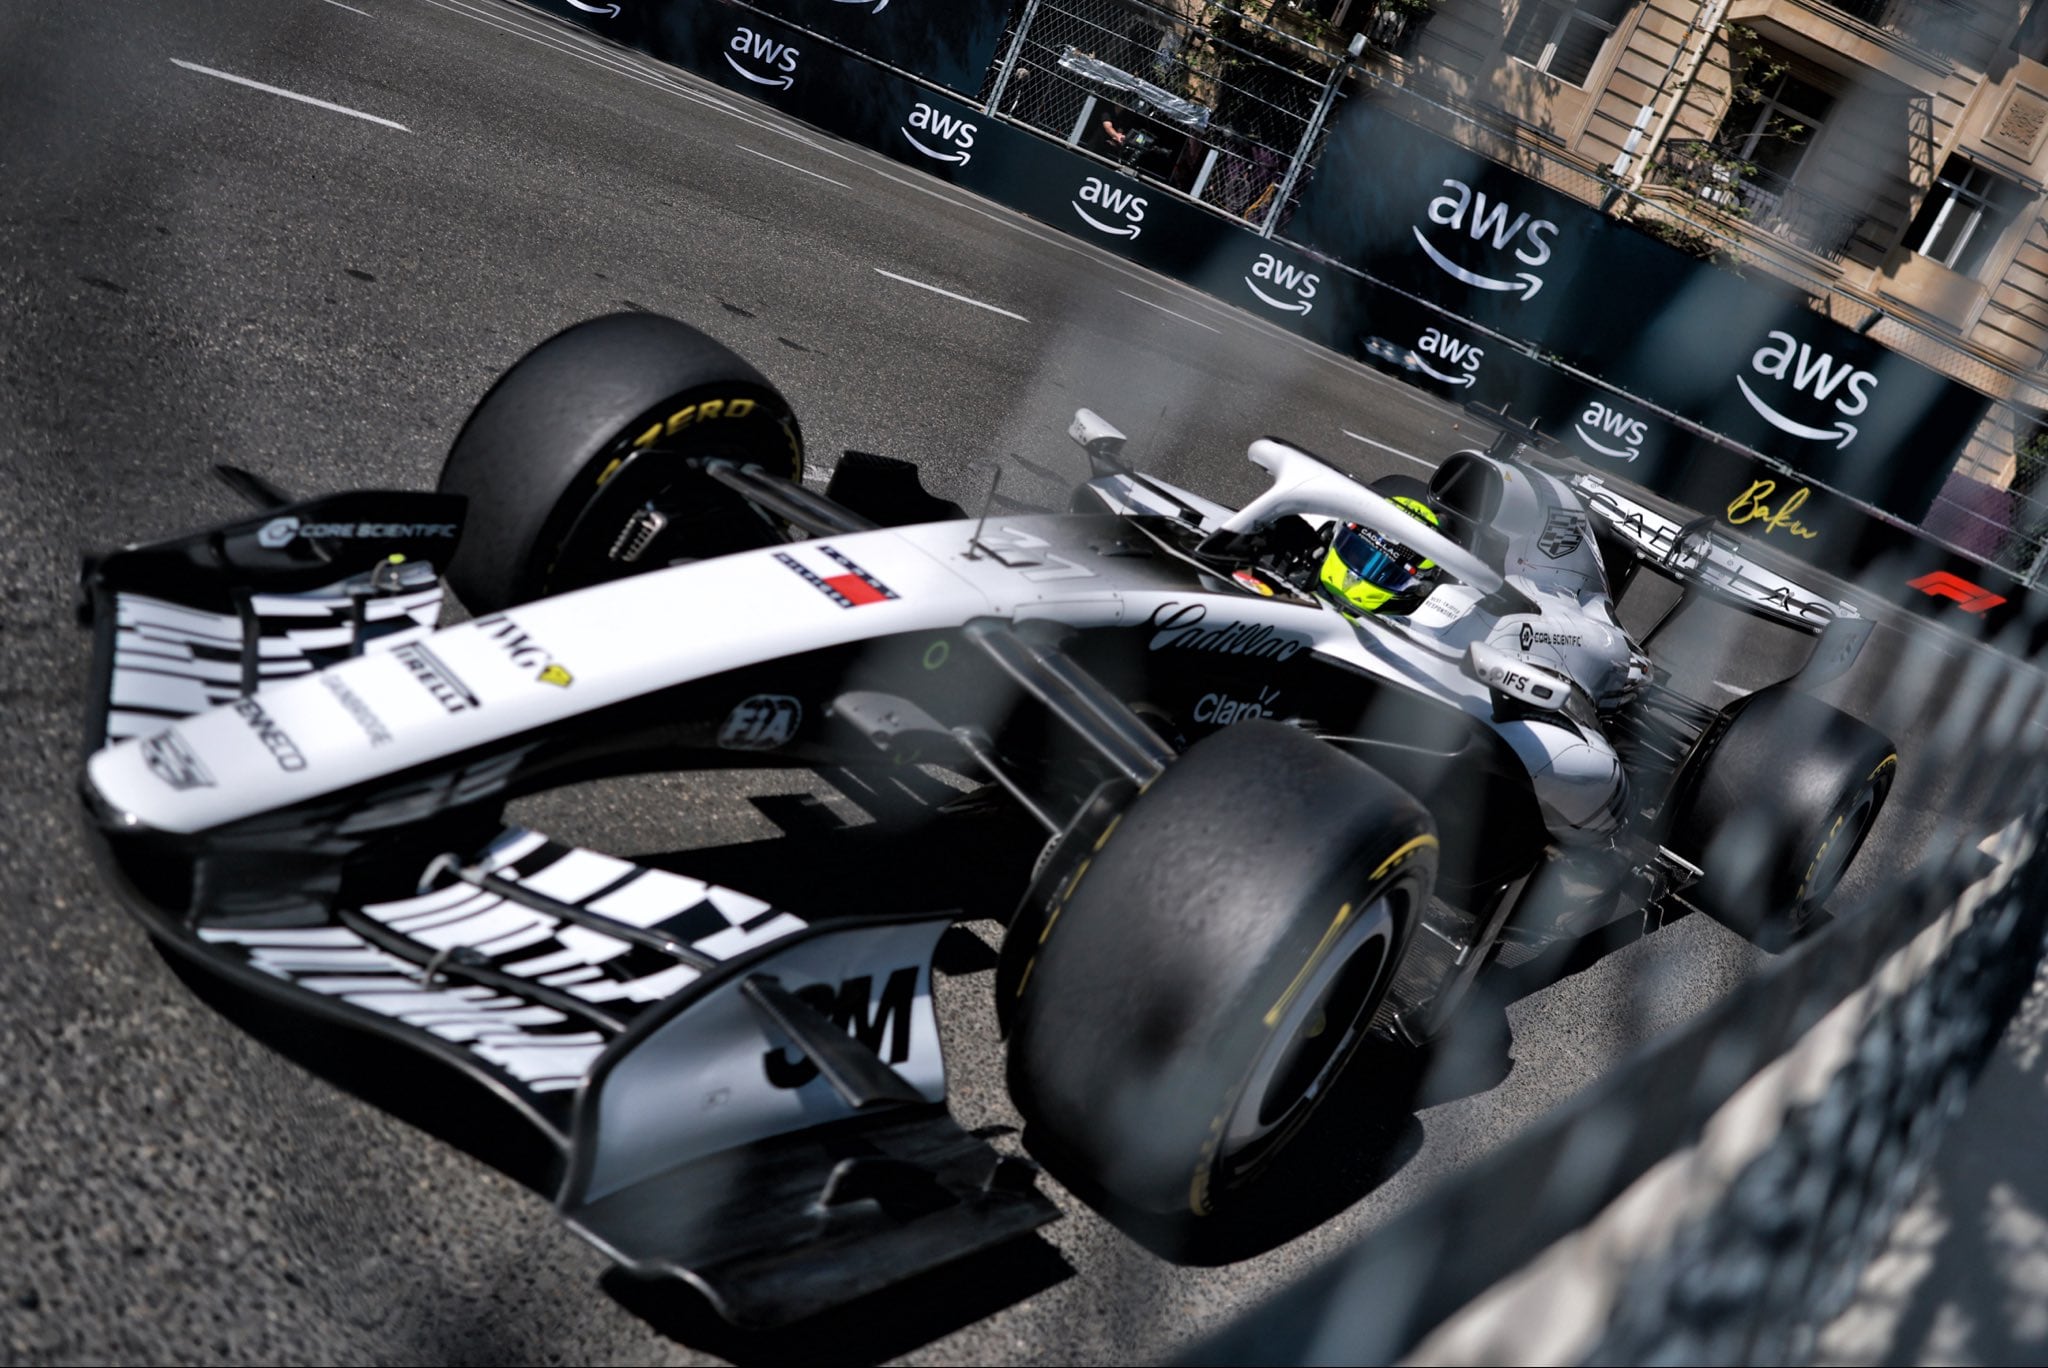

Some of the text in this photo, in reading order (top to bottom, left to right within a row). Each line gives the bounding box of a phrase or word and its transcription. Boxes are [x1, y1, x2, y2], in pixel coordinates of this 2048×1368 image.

[730, 27, 800, 72] aws
[908, 102, 978, 149] aws
[1079, 176, 1148, 222] aws
[1428, 178, 1560, 267] aws
[1251, 253, 1320, 299] aws
[1418, 327, 1484, 372] aws
[1752, 330, 1879, 417] aws
[1582, 401, 1648, 447] aws
[300, 523, 355, 539] CORE
[1726, 479, 1818, 540] Baku
[1150, 601, 1300, 663] Cadillac
[1502, 670, 1530, 693] IFS
[727, 707, 792, 743] FIA
